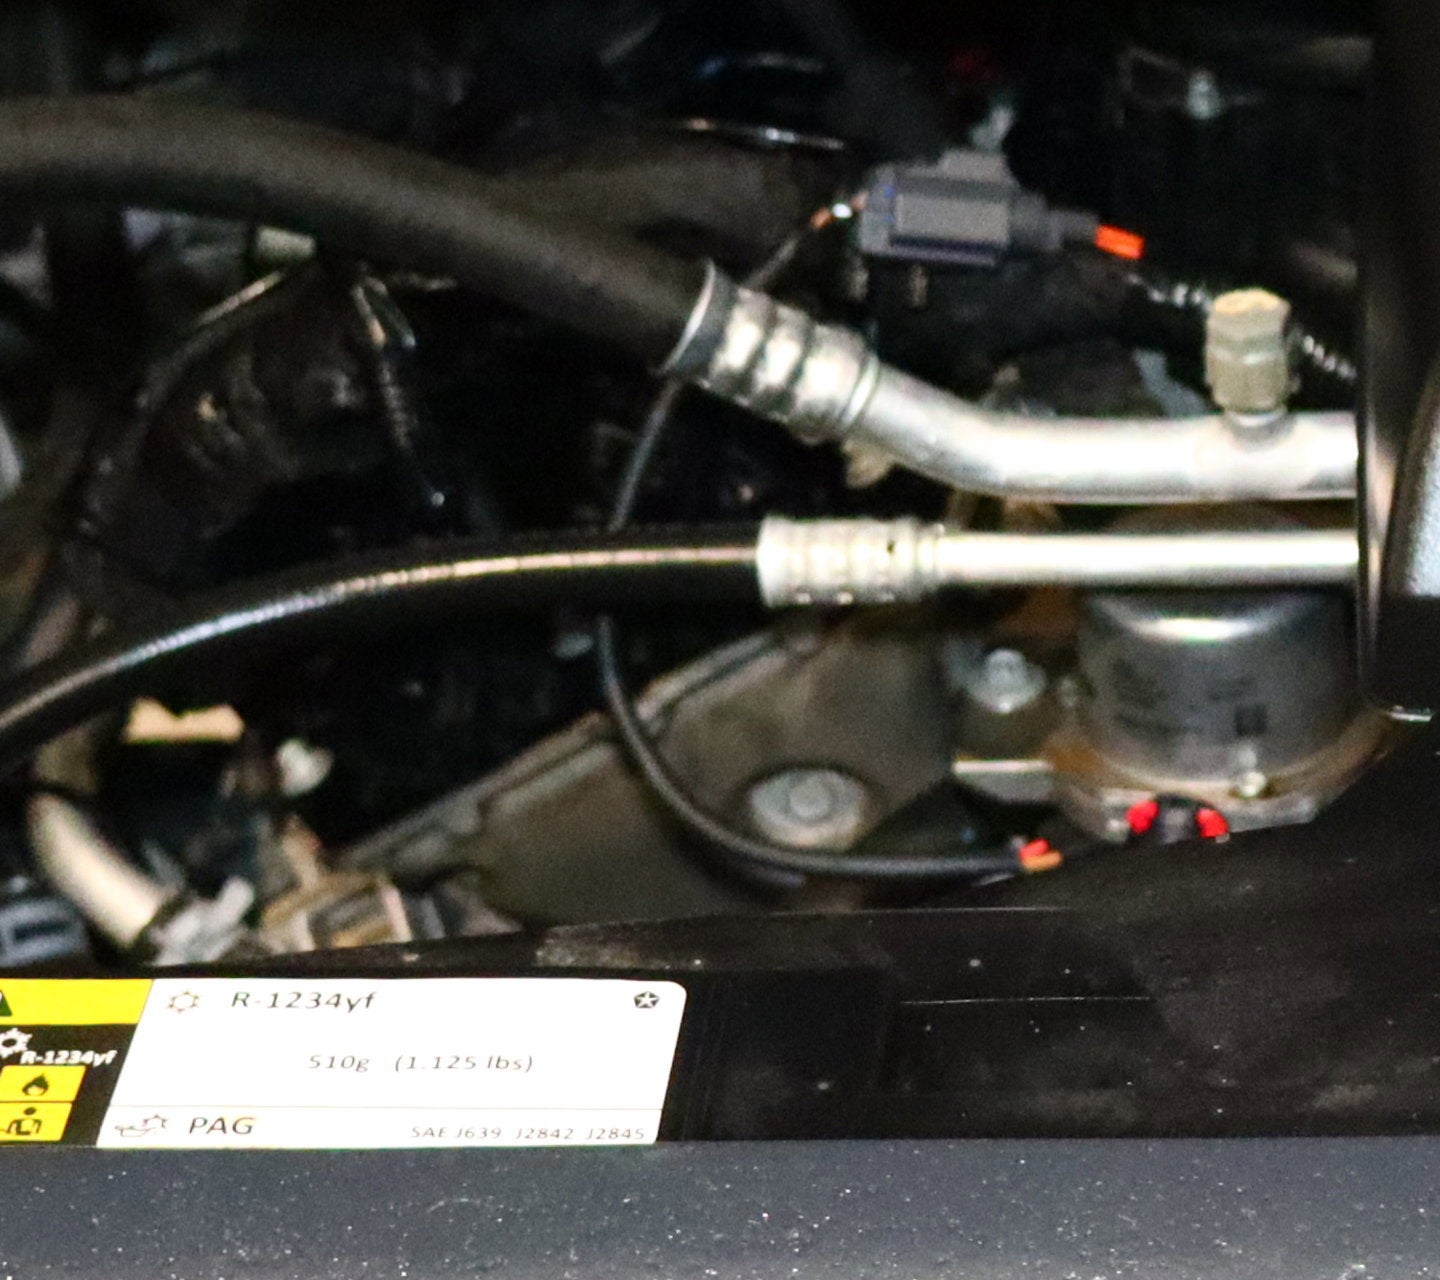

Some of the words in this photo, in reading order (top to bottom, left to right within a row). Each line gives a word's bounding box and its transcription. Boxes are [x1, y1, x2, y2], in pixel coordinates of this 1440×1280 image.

[231, 990, 377, 1013] R-1234yf
[20, 1049, 119, 1068] R-1234yf
[309, 1054, 370, 1073] 510g
[394, 1054, 477, 1073] (1.125
[487, 1054, 534, 1073] lbs)
[188, 1117, 257, 1135] PAG
[411, 1126, 447, 1139] SAE
[456, 1126, 503, 1140] J639
[515, 1127, 575, 1141] J2842
[585, 1127, 646, 1141] J2845
